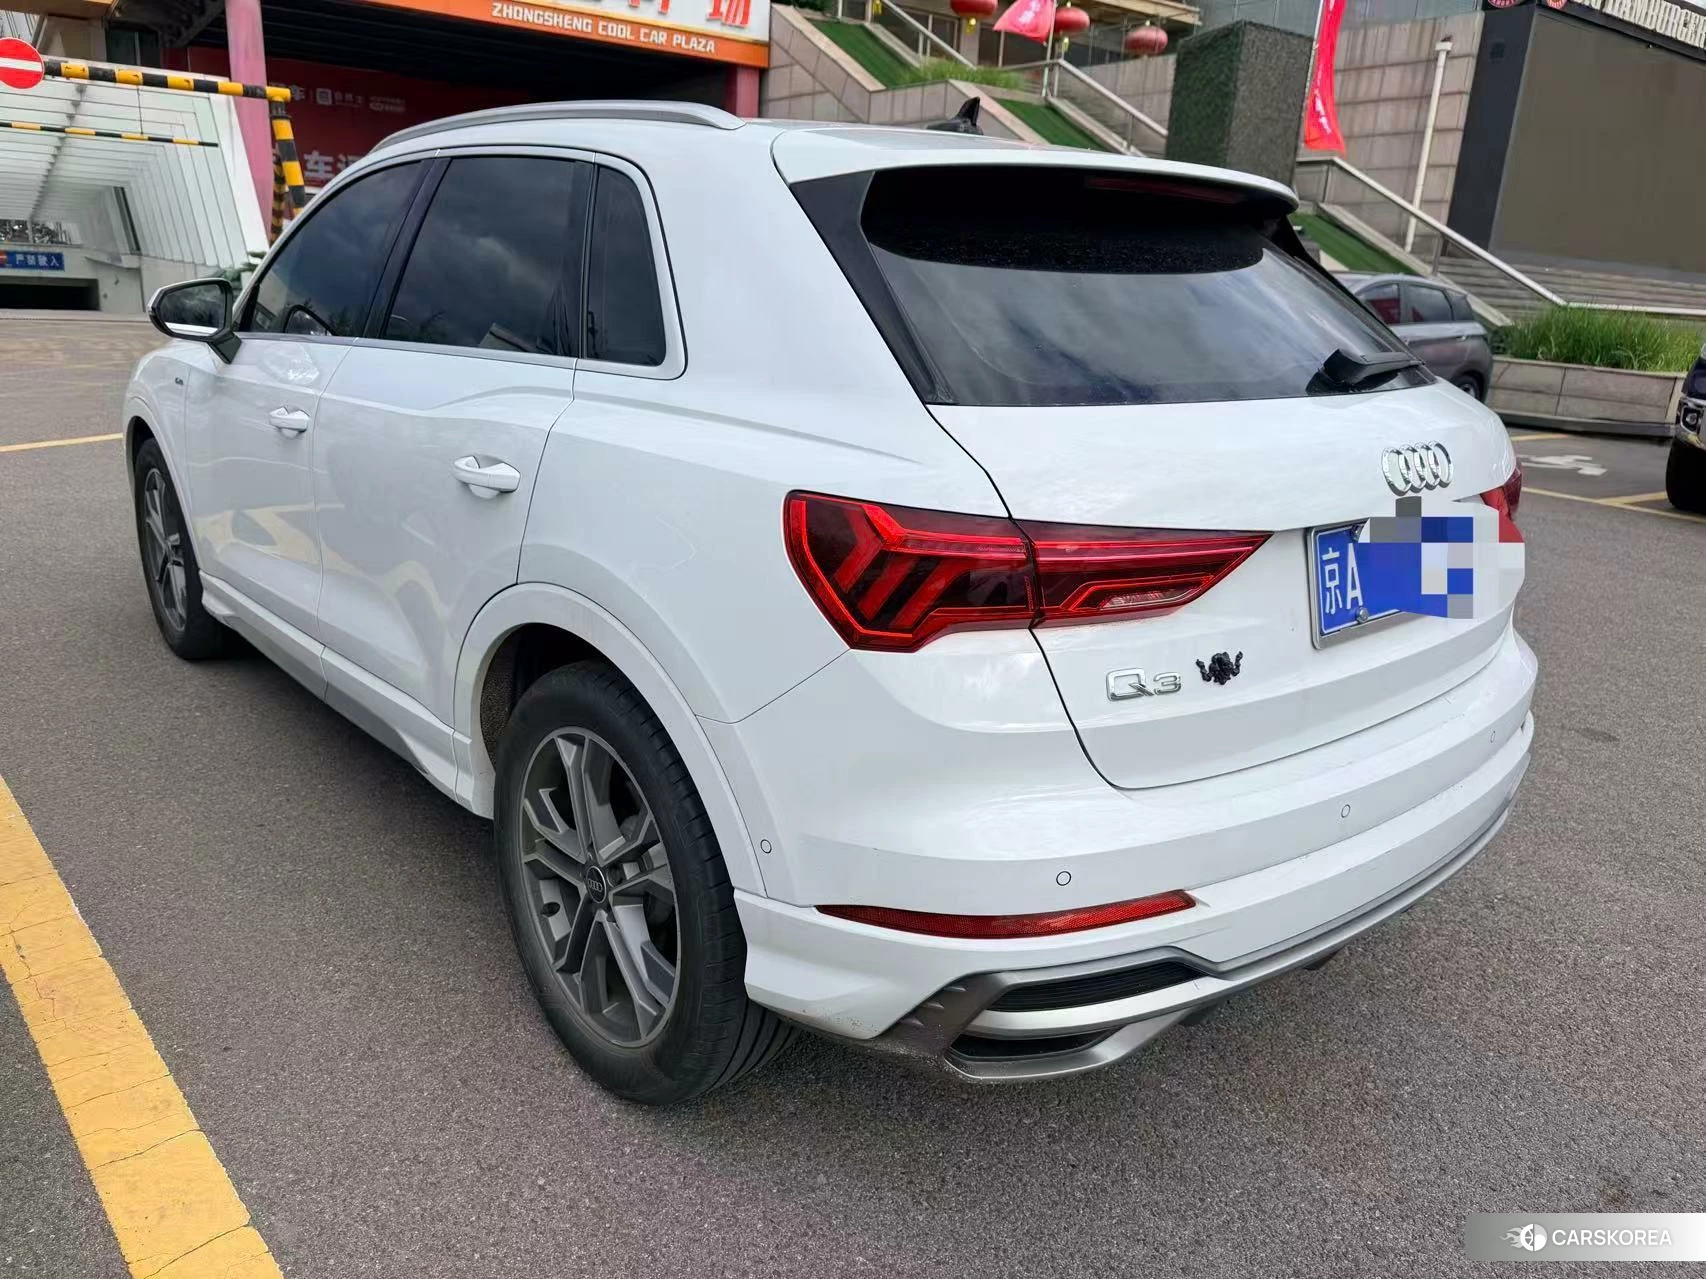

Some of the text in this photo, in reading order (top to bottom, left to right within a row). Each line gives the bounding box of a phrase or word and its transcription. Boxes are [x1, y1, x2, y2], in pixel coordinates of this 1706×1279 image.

[491, 2, 715, 53] ZHONGSHENG COOL CAR PLAZA
[1106, 667, 1181, 702] Q3
